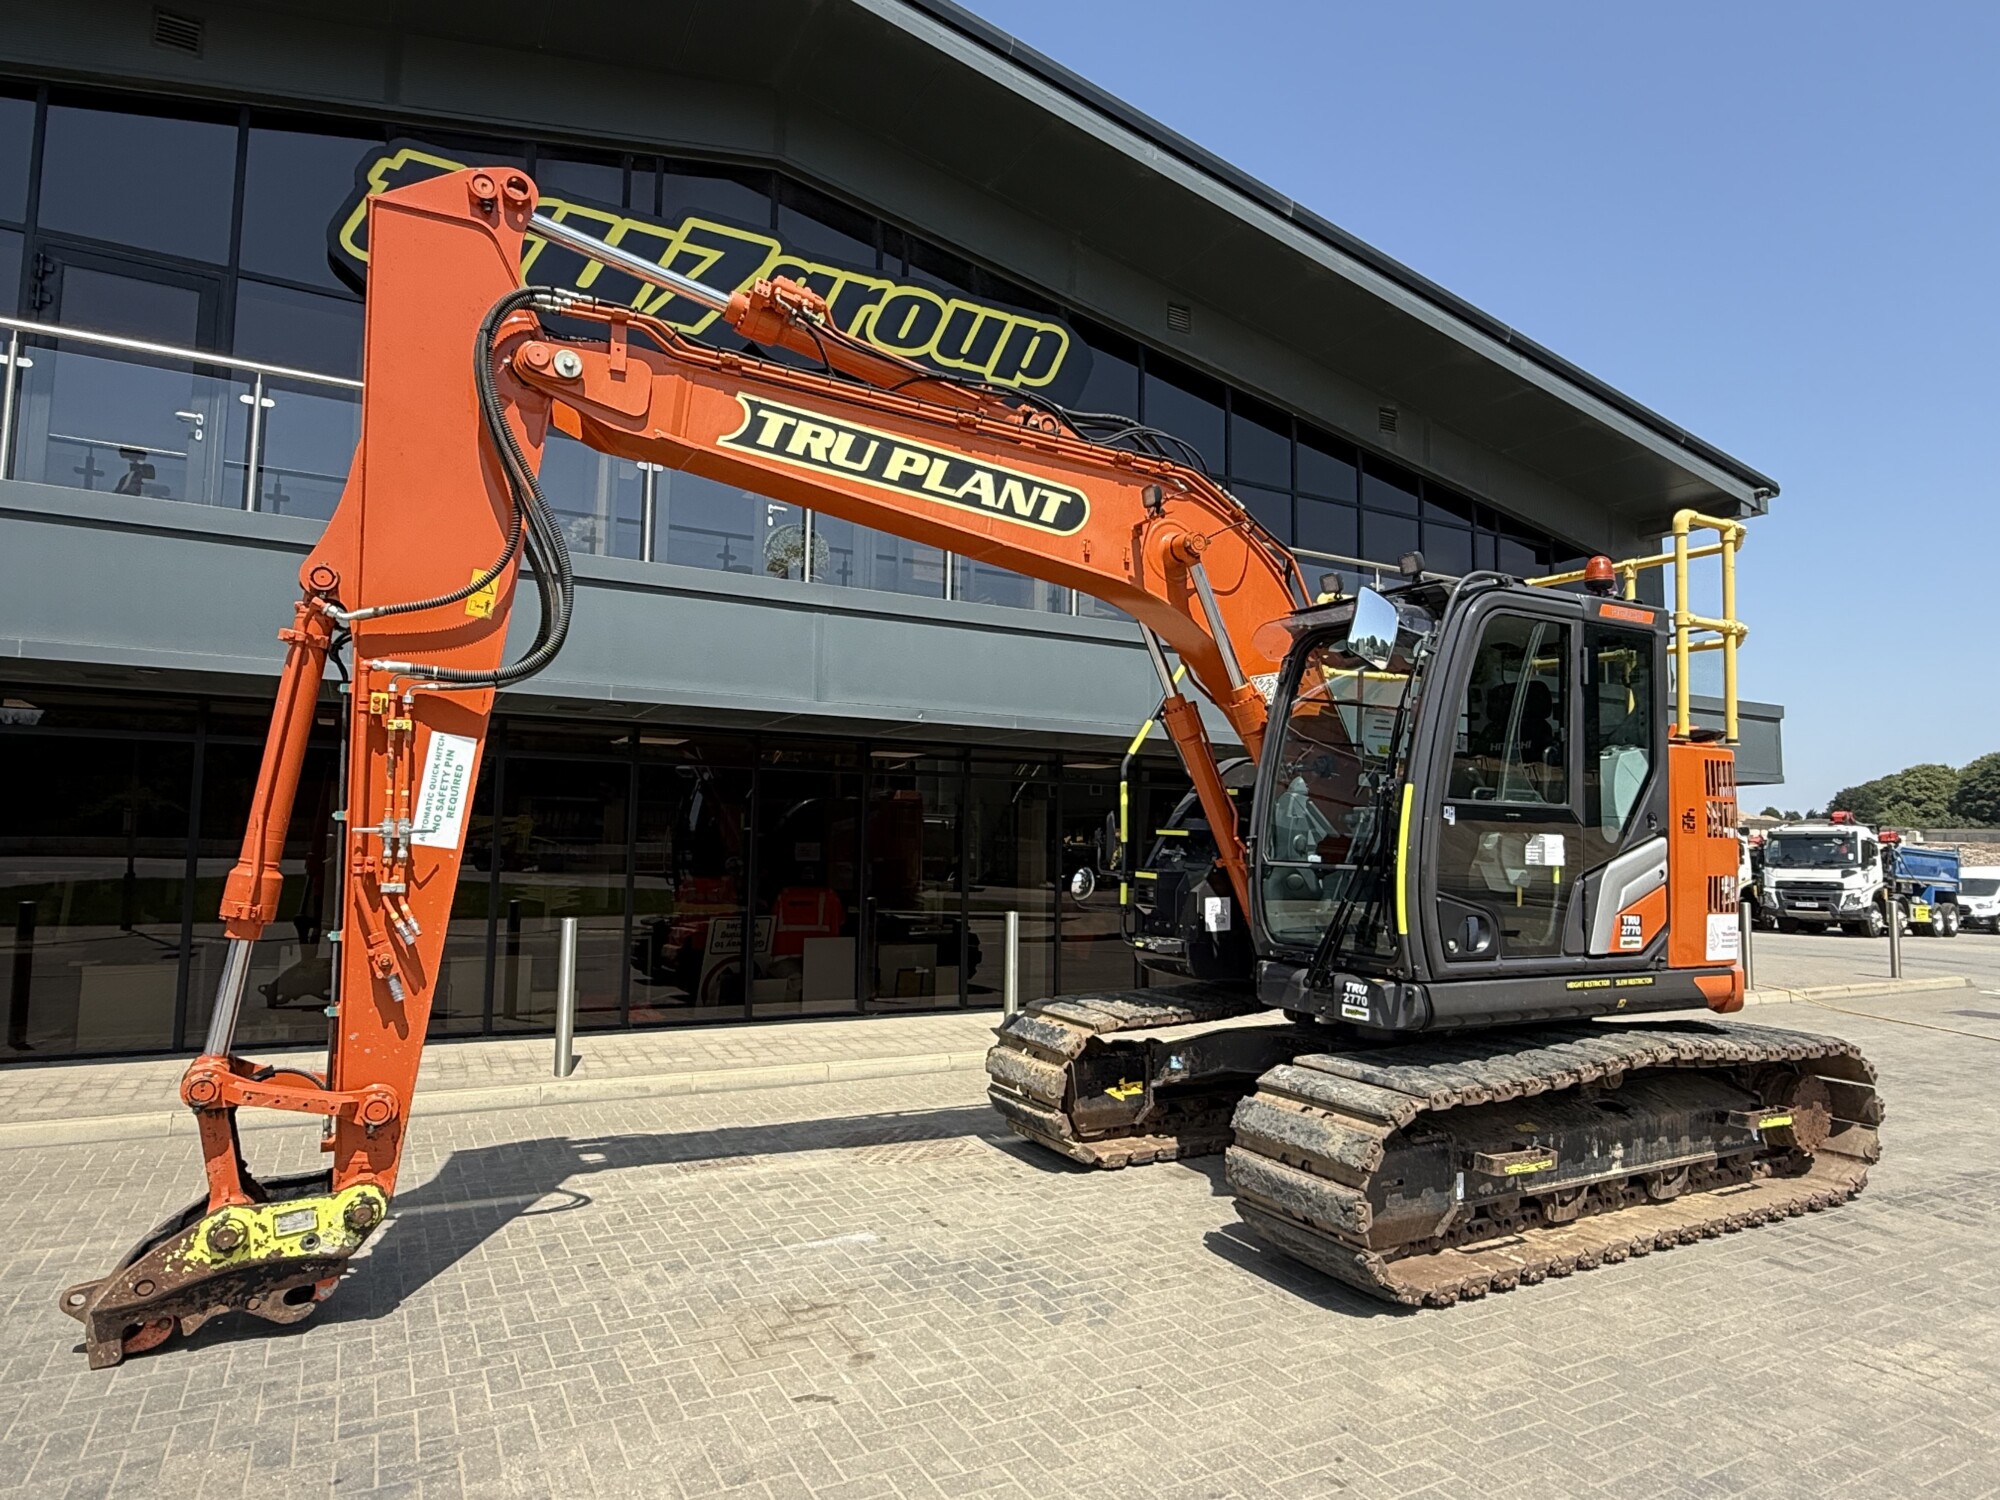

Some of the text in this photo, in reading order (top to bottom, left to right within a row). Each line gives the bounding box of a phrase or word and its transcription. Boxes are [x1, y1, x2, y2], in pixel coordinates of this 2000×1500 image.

[756, 409, 1072, 524] TRU PLANT
[1489, 740, 1532, 752] HITCHI
[419, 735, 446, 842] ATOMATIC QUICK HITCH
[432, 749, 456, 832] NO SAFETY PIN
[446, 764, 464, 819] REQUIRED
[1621, 915, 1641, 926] TRU
[1621, 925, 1642, 936] 2770
[1345, 981, 1369, 995] TRU
[1343, 992, 1368, 1007] 2770
